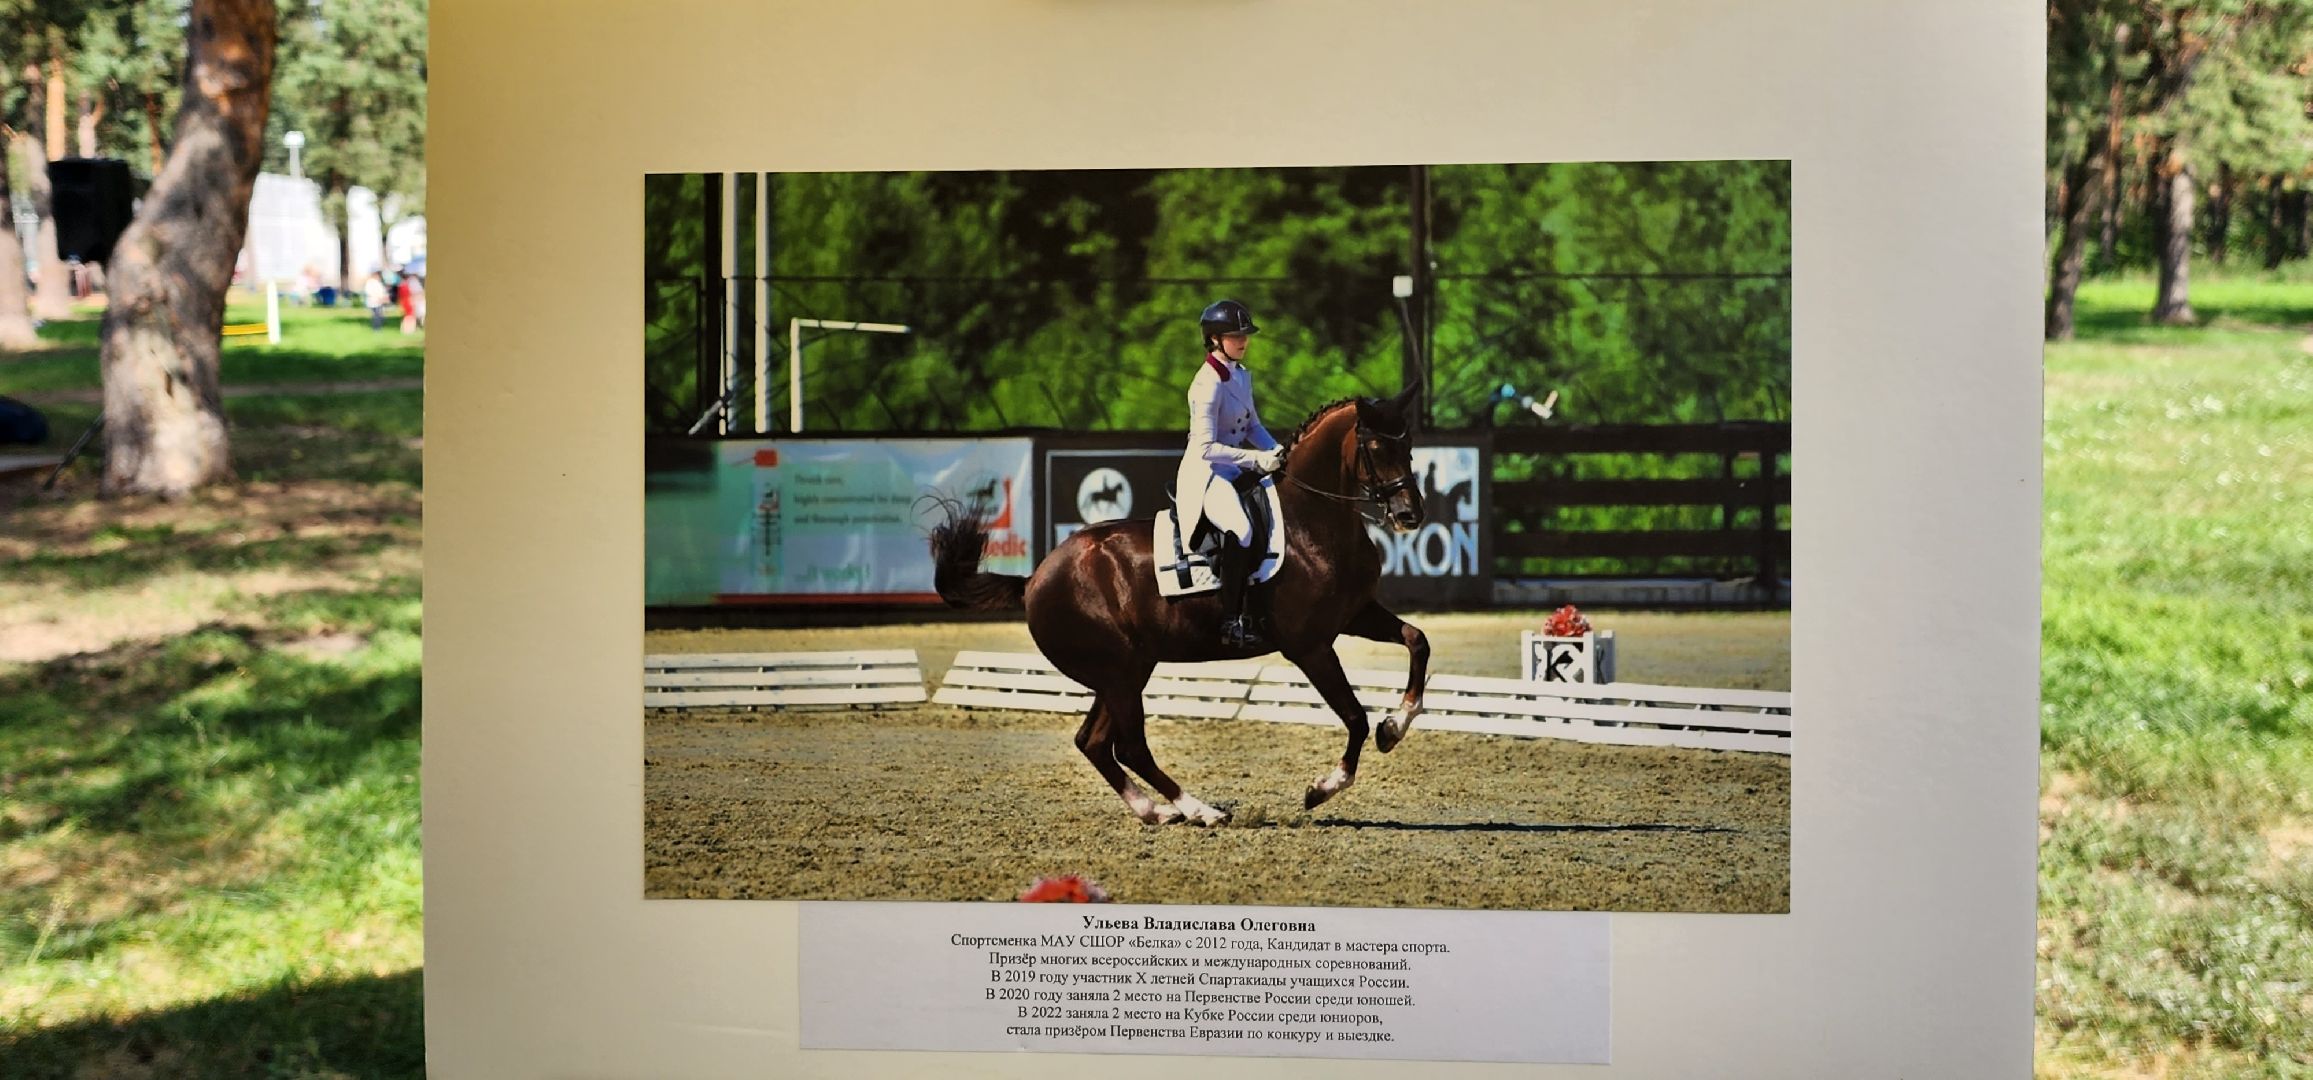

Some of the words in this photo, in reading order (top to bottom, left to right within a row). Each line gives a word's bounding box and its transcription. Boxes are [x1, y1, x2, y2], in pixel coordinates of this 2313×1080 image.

[1082, 915, 1139, 930] Ульева
[1143, 916, 1236, 932] Владислава
[1240, 917, 1316, 932] Олеговна
[951, 933, 1037, 949] Спортсменка
[1040, 934, 1076, 947] МАУ
[1079, 935, 1125, 948] СШОР
[1128, 935, 1182, 949] «Белка»
[1185, 939, 1192, 949] с
[1195, 936, 1227, 949] 2012
[1231, 940, 1263, 952] года,
[1267, 937, 1331, 952] Кандидат
[1334, 942, 1342, 951] в
[1346, 942, 1399, 956] мастера
[1401, 943, 1450, 956] спорта.
[989, 951, 1037, 968] Призёр
[1040, 956, 1088, 965] многих
[1091, 954, 1188, 969] всероссийских
[1192, 958, 1200, 967] и
[1204, 958, 1312, 971] международных
[1315, 958, 1411, 972] соревнований.
[991, 969, 1001, 982] В
[1005, 969, 1036, 983] 2019
[1039, 973, 1069, 986] году
[1072, 974, 1132, 986] участник
[1150, 973, 1195, 985] летней
[1198, 972, 1287, 989] Спартакиады
[1290, 977, 1355, 990] учащихся
[1359, 975, 1410, 989] России.
[986, 988, 996, 1000] В
[999, 987, 1030, 1000] 2020
[1034, 991, 1063, 1004] году
[1066, 992, 1110, 1001] заняла
[1113, 989, 1121, 1001] 2
[1124, 992, 1162, 1002] место
[1166, 993, 1181, 1002] на
[1185, 990, 1261, 1006] Первенстве
[1264, 991, 1311, 1005] России
[1315, 995, 1353, 1008] среди
[1357, 994, 1415, 1006] юношей.
[1017, 1006, 1028, 1018] В
[1031, 1006, 1062, 1019] 2022
[1065, 1009, 1110, 1019] заняла
[1112, 1007, 1120, 1019] 2
[1124, 1010, 1162, 1020] место
[1165, 1011, 1181, 1020] на
[1184, 1007, 1225, 1023] Кубке
[1228, 1009, 1274, 1022] России
[1278, 1013, 1316, 1025] среди
[1320, 1014, 1383, 1027] юниоров,
[1006, 1026, 1041, 1036] стала
[1045, 1025, 1107, 1039] призёром
[1110, 1024, 1186, 1041] Первенства
[1190, 1026, 1243, 1042] Евразии
[1247, 1030, 1263, 1039] по
[1267, 1030, 1321, 1043] конкуру
[1325, 1032, 1334, 1041] и
[1338, 1032, 1395, 1043] выездке.
